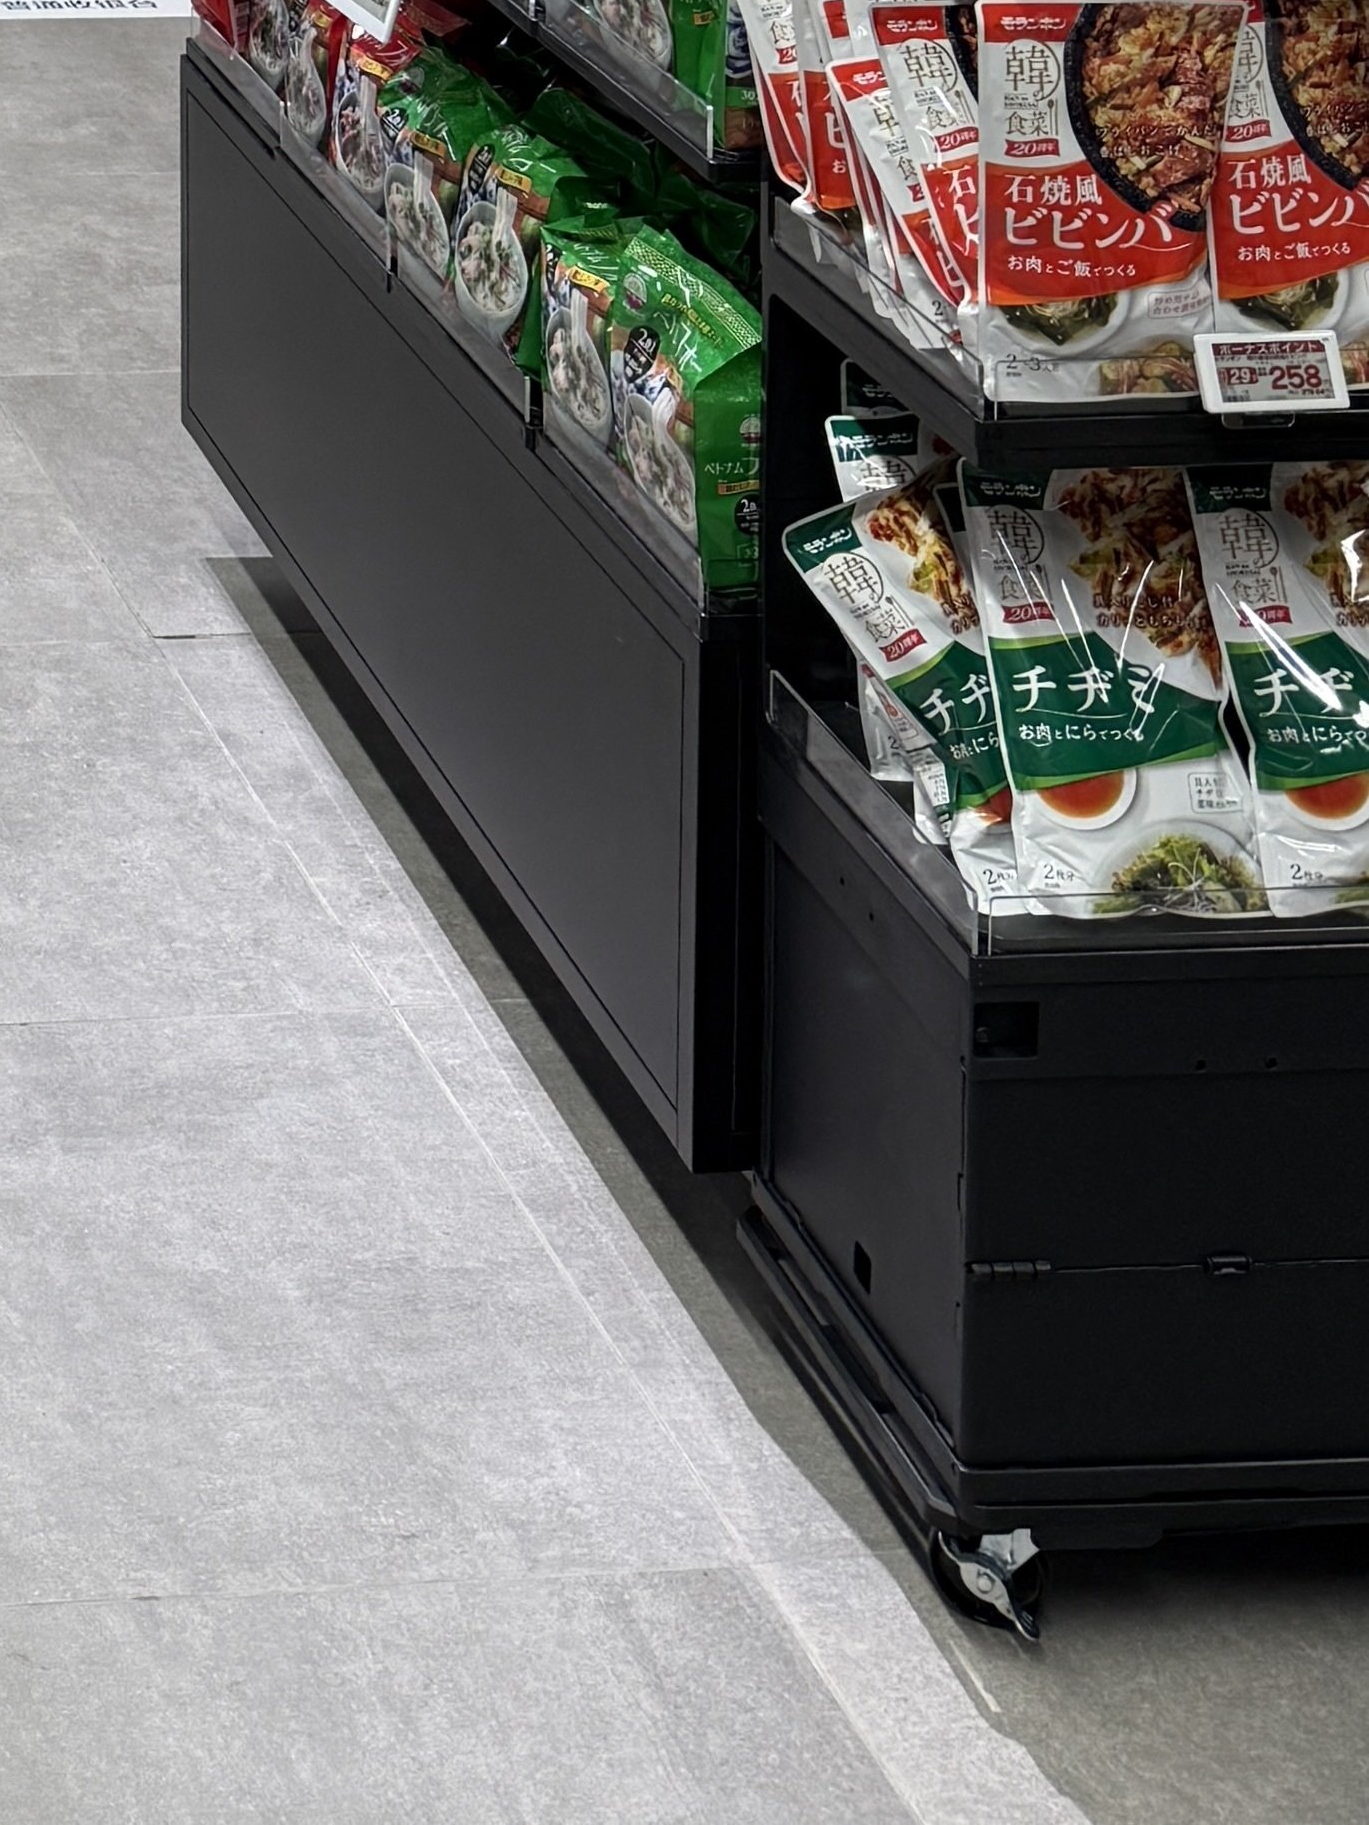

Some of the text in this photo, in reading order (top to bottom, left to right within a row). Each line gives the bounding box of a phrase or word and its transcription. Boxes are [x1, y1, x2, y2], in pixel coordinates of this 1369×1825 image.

[886, 19, 939, 34] モランボン
[1000, 15, 1067, 31] モランボン
[902, 42, 955, 92] 韓
[1004, 41, 1056, 96] 韓
[1005, 111, 1049, 137] 食菜
[1227, 155, 1312, 189] 石焼風
[1004, 172, 1102, 207] 石焼風
[1003, 200, 1176, 252] ビビンバ
[1007, 254, 1137, 278] お肉とご飯でつくる
[1237, 240, 1352, 264] お肉とご飯でつくる
[1219, 343, 1317, 356] ボーナスポイント
[1270, 364, 1324, 391] 258
[979, 480, 1043, 499] モランボン
[1208, 484, 1267, 501] モランボン
[987, 507, 1039, 564] 韓
[1219, 511, 1275, 568] 韓
[823, 553, 877, 608] 韓
[1013, 662, 1157, 716] チヂミ
